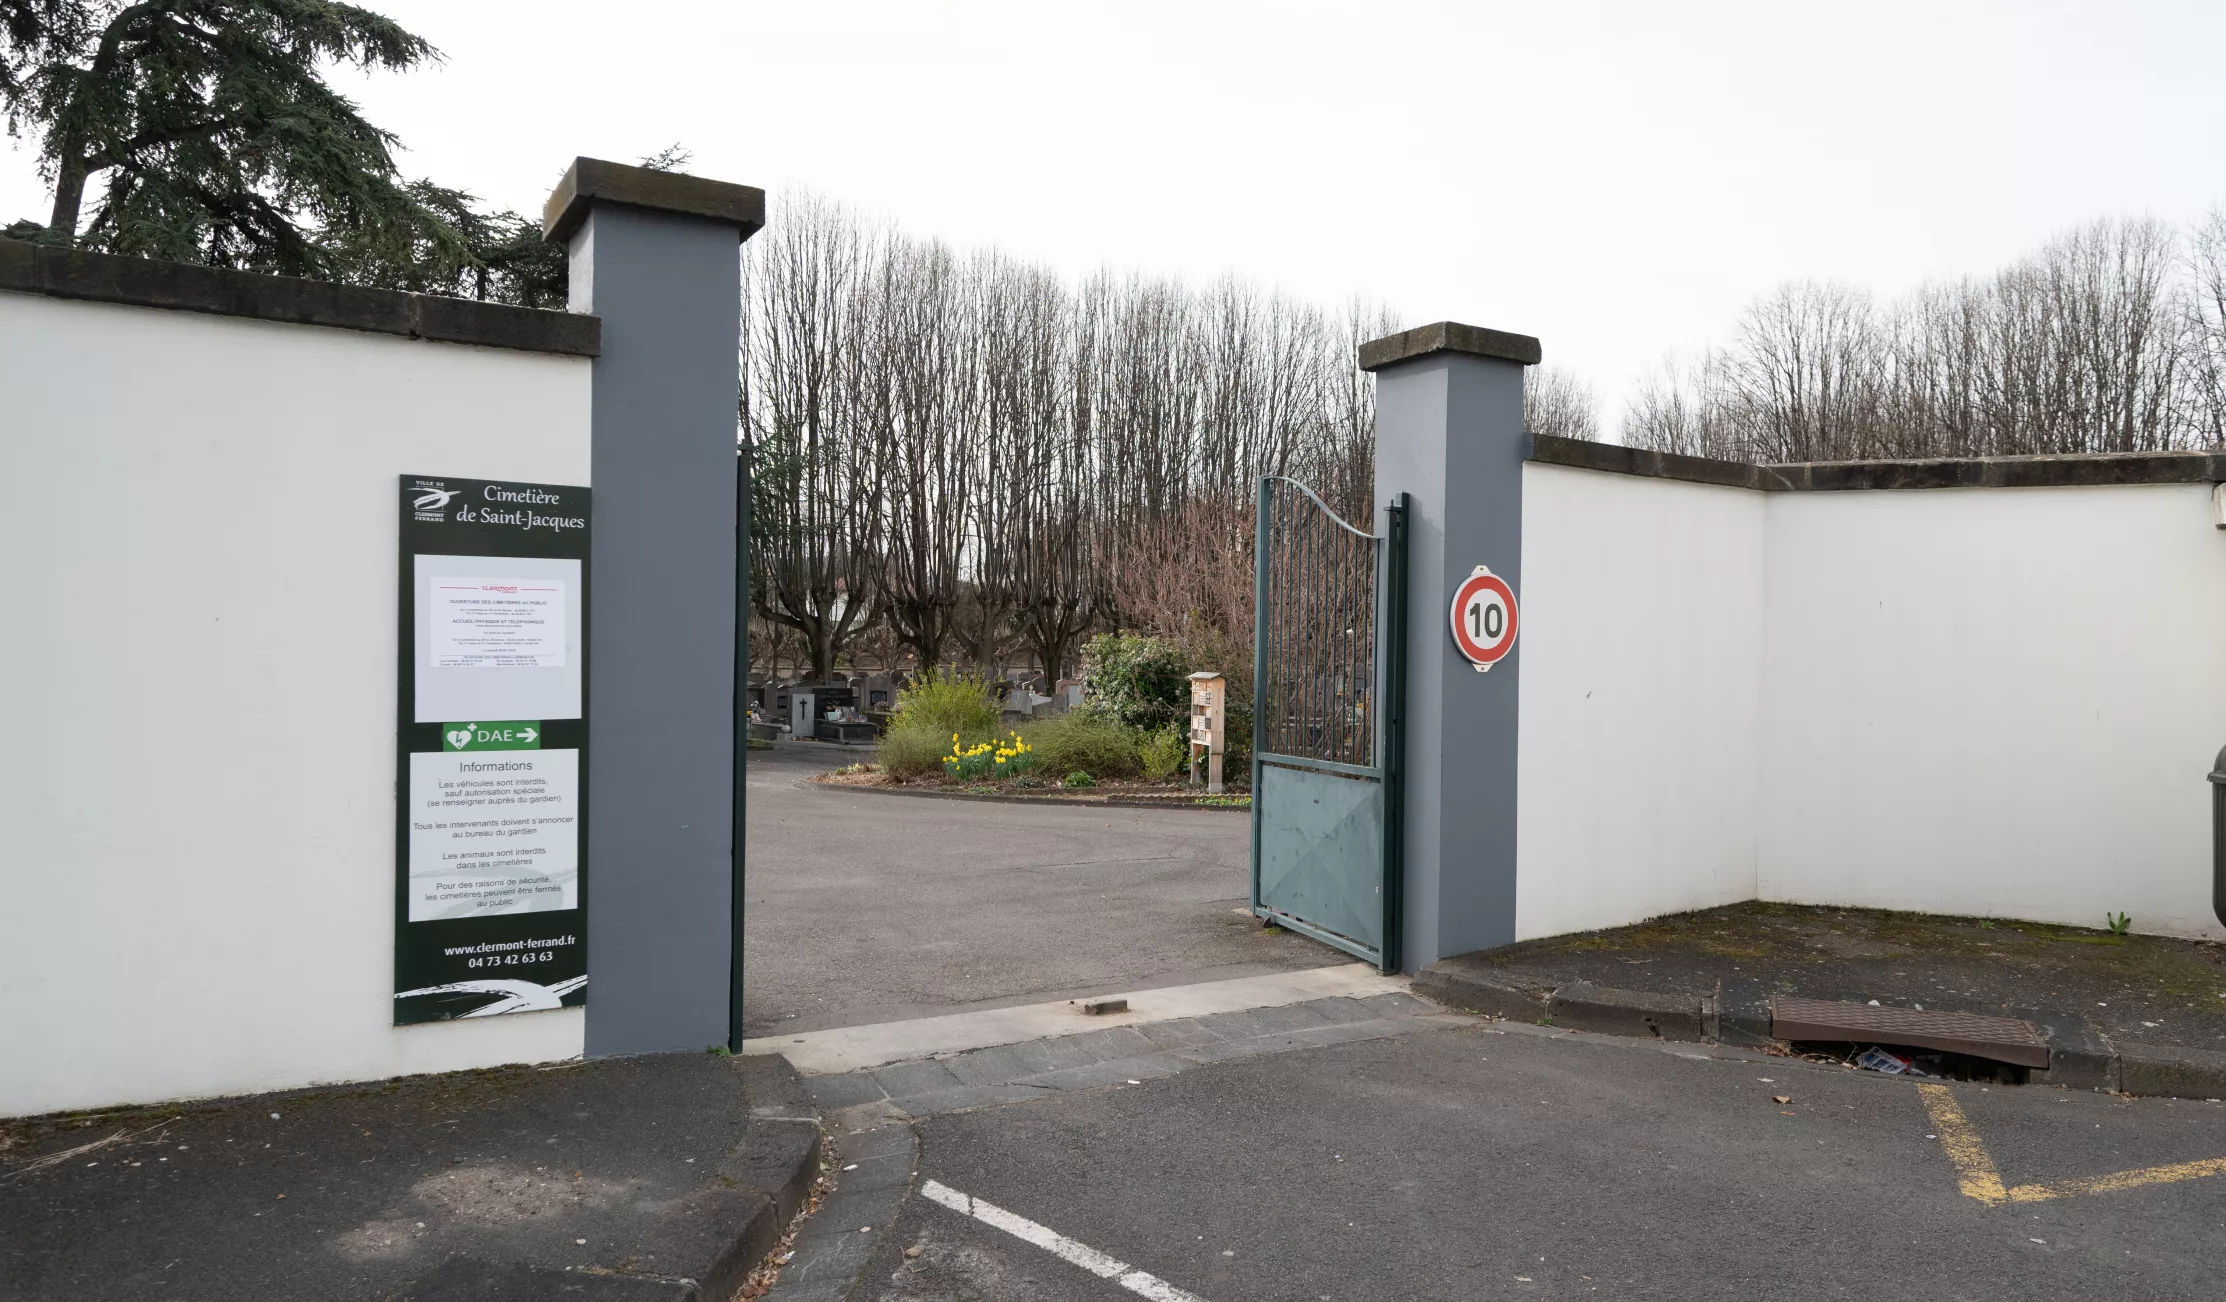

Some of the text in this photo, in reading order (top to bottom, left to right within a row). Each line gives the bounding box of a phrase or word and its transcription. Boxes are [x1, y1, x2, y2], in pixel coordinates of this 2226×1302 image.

[484, 485, 560, 505] Cimetière
[456, 504, 585, 532] de Saint-Jacques
[1470, 603, 1502, 638] 10
[477, 729, 513, 742] DAE
[459, 762, 533, 773] Informations
[456, 779, 494, 788] véhicules
[444, 787, 545, 798] sauf autorisation spéciale
[427, 794, 562, 808] (se renseigner auprès du gardien)
[435, 821, 447, 829] les
[449, 819, 499, 829] intervenants
[501, 818, 529, 826] doivent
[465, 829, 494, 838] bureau
[495, 829, 506, 837] du
[507, 827, 537, 838] gardien
[442, 847, 546, 860] Les animaux sont interdits
[456, 858, 533, 869] dans les cimetières
[436, 882, 456, 890] Pour
[458, 881, 473, 889] des
[475, 879, 504, 888] raisons
[506, 878, 517, 886] de
[425, 893, 438, 901] les
[483, 889, 516, 898] peuvent
[517, 887, 533, 895] être
[534, 885, 562, 893] fermés
[489, 898, 513, 908] public
[444, 935, 576, 956] www.clermont-ferrand.fr
[468, 951, 553, 968] 04 73 42 63 63
